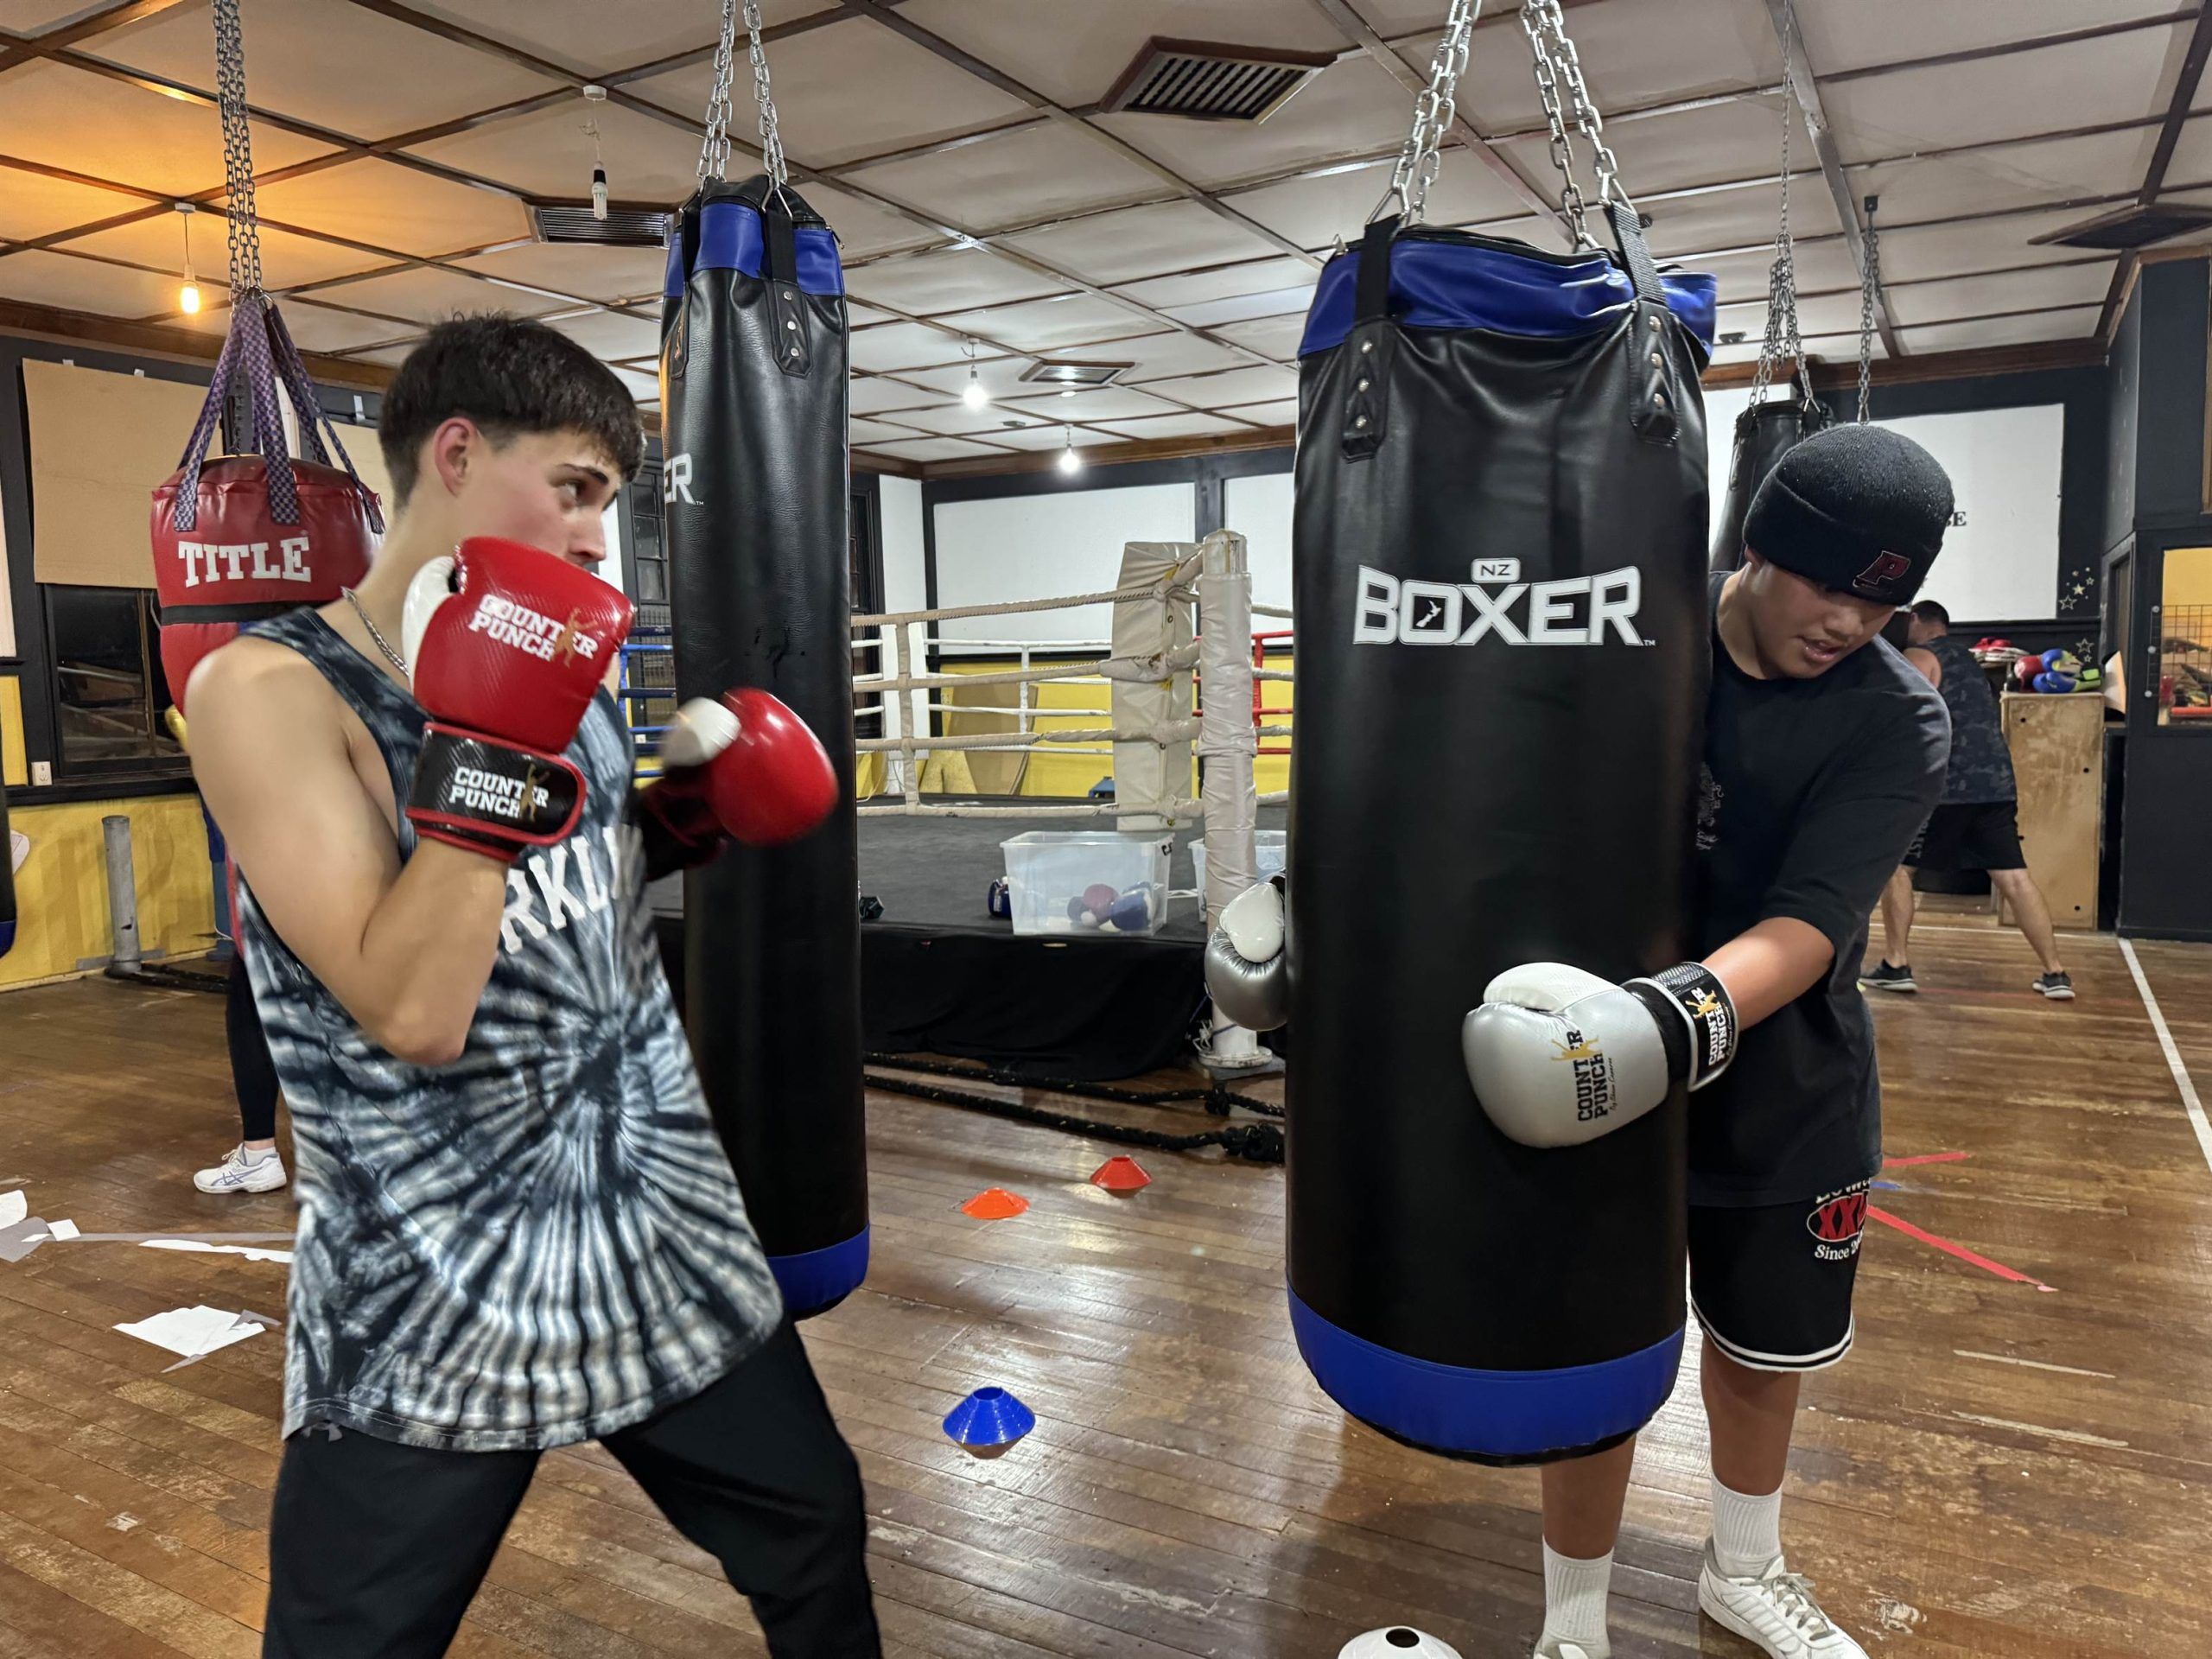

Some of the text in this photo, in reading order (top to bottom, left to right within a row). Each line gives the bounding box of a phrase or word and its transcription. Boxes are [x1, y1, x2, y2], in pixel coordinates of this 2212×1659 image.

[178, 537, 312, 588] TITLE
[1480, 563, 1511, 577] NZ
[1352, 563, 1643, 646] BOXER
[1814, 1244, 1850, 1261] Since
